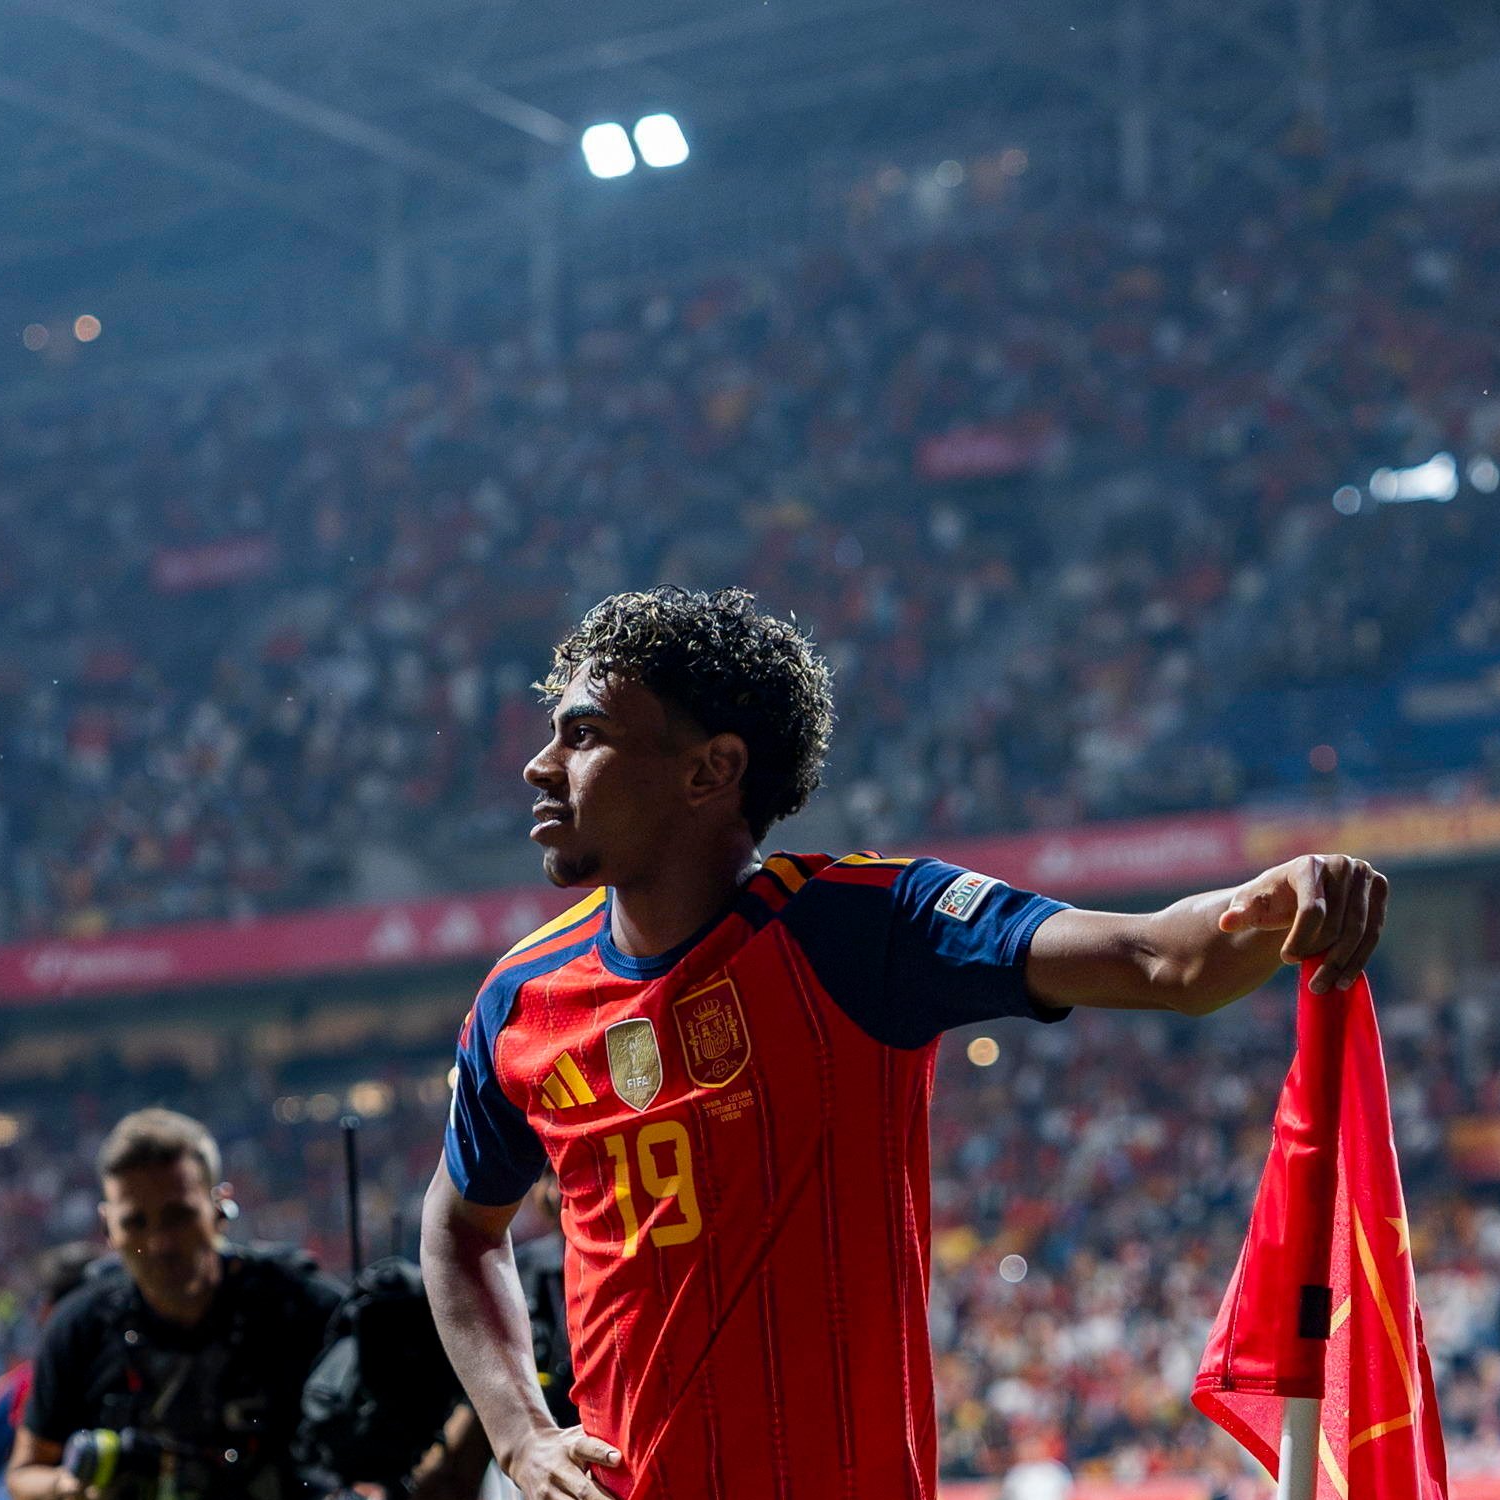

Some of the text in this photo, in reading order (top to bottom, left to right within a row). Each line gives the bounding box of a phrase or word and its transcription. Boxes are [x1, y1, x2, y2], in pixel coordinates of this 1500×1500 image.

[939, 889, 958, 910] UEFA
[627, 1075, 649, 1088] FIFA
[604, 1120, 702, 1259] 19
